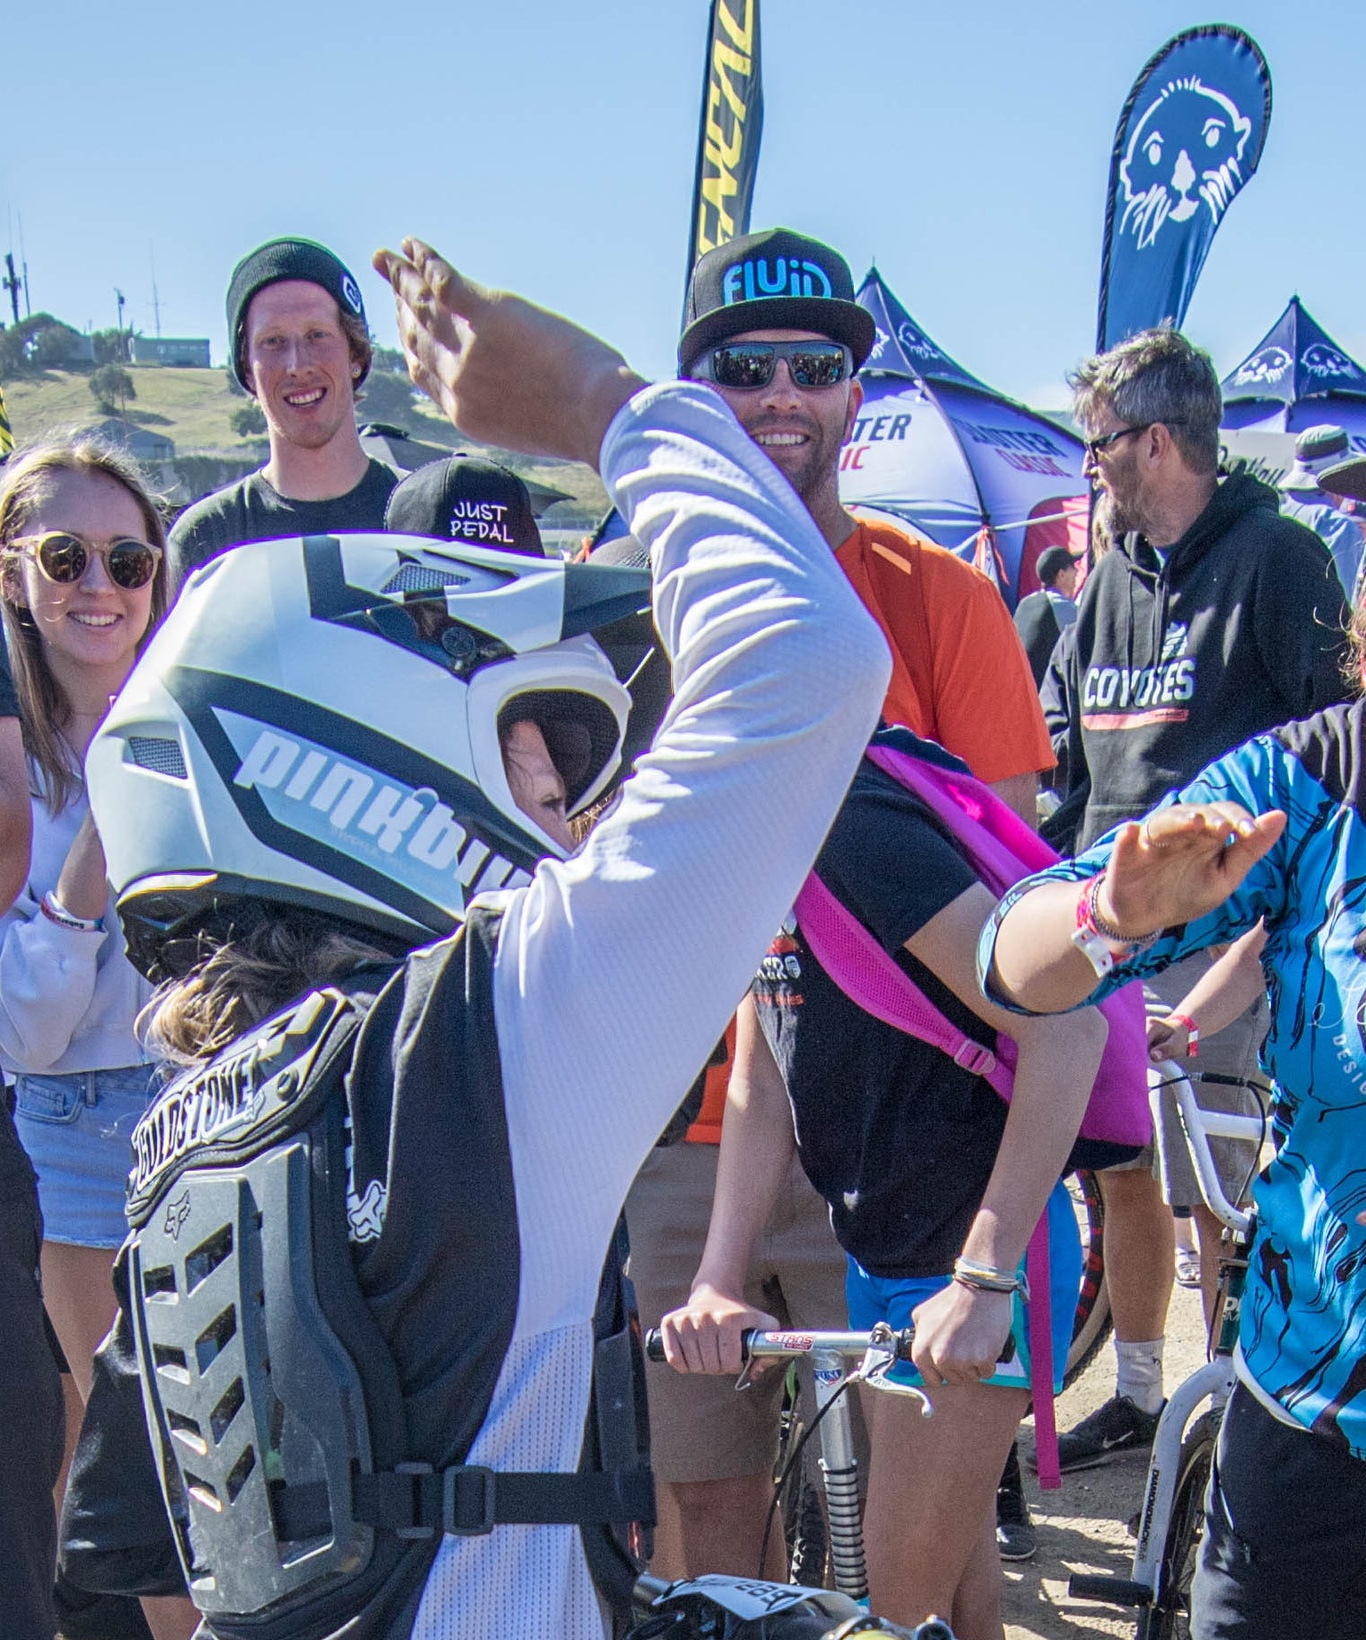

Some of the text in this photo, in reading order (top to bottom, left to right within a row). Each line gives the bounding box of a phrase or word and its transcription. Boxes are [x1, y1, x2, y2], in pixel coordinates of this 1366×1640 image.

[851, 413, 913, 443] TER
[452, 502, 509, 524] JUST
[449, 521, 515, 545] PEDAL
[1082, 657, 1196, 710] COYOTES
